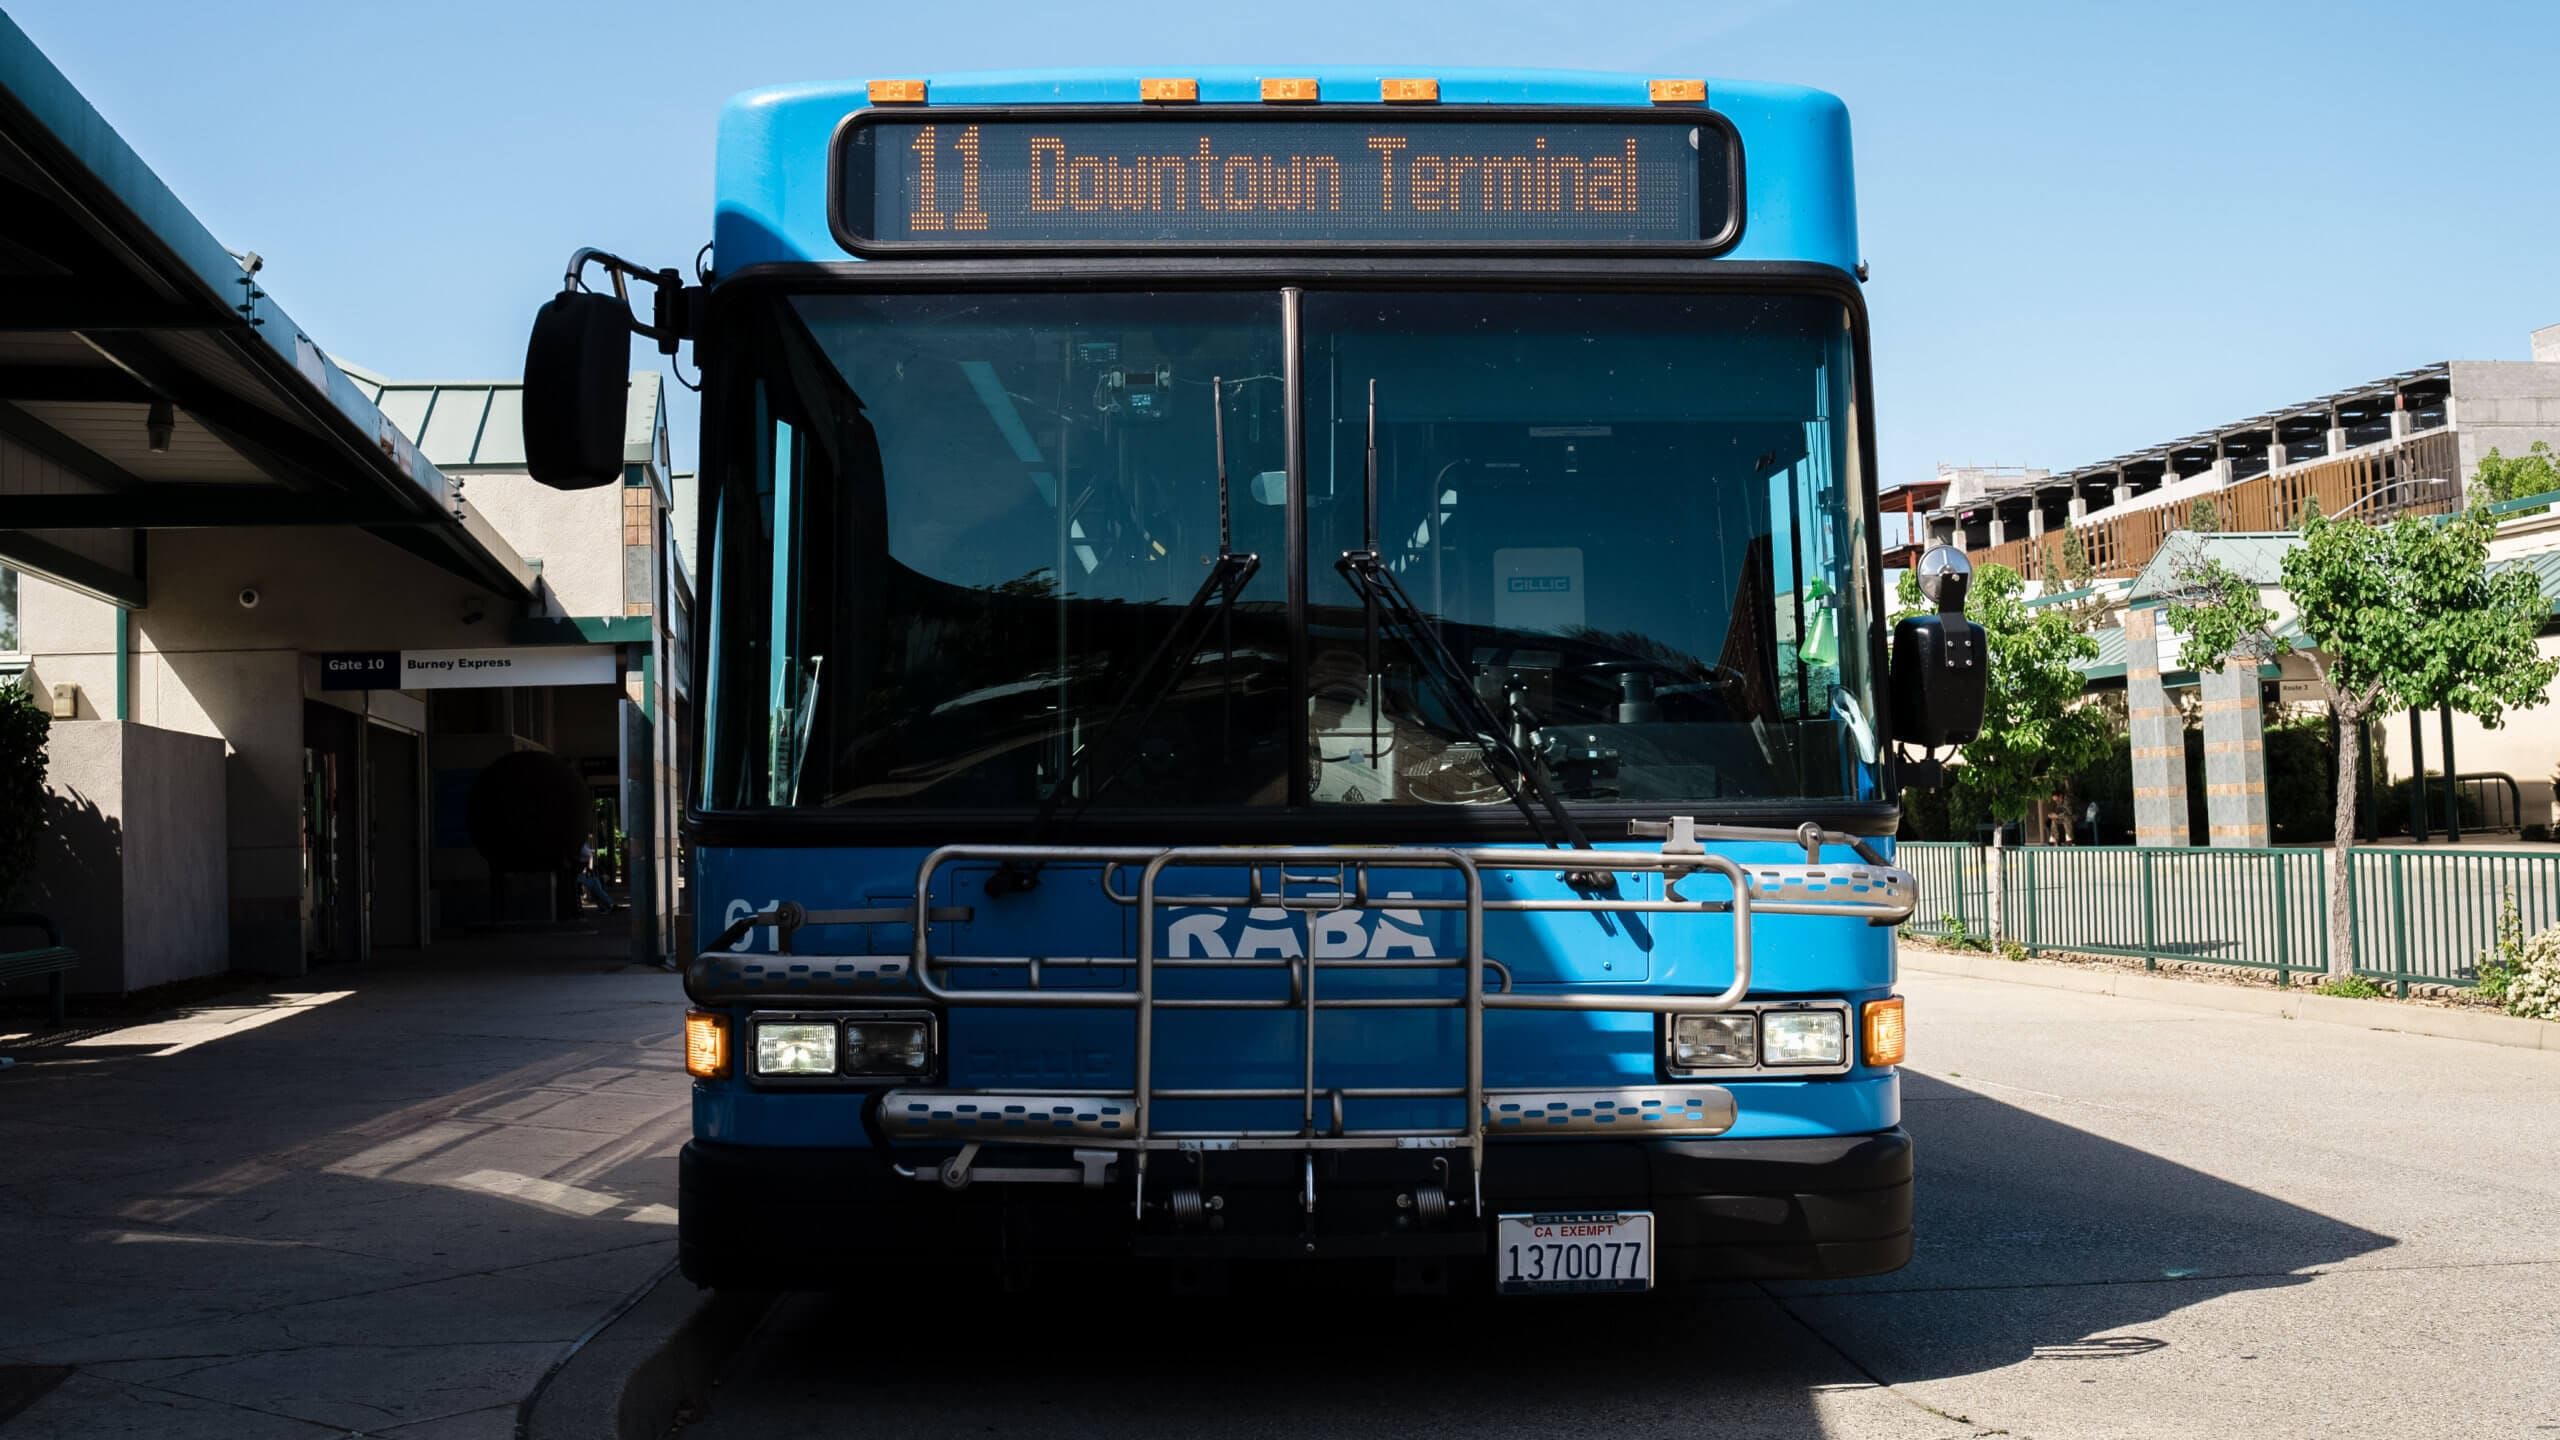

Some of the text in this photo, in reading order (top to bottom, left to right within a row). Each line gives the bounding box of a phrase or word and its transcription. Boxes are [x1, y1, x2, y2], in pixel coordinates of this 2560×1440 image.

[911, 125, 1638, 231] 11 Downtown Terminal
[1510, 578, 1569, 591] GILLIG
[328, 658, 385, 671] Gate 10
[407, 658, 512, 671] Burney Express
[1168, 891, 1436, 958] RABA
[1535, 1215, 1617, 1224] GILLIG
[1534, 1225, 1614, 1238] CA EXEMPT
[1507, 1242, 1642, 1281] 1370077
